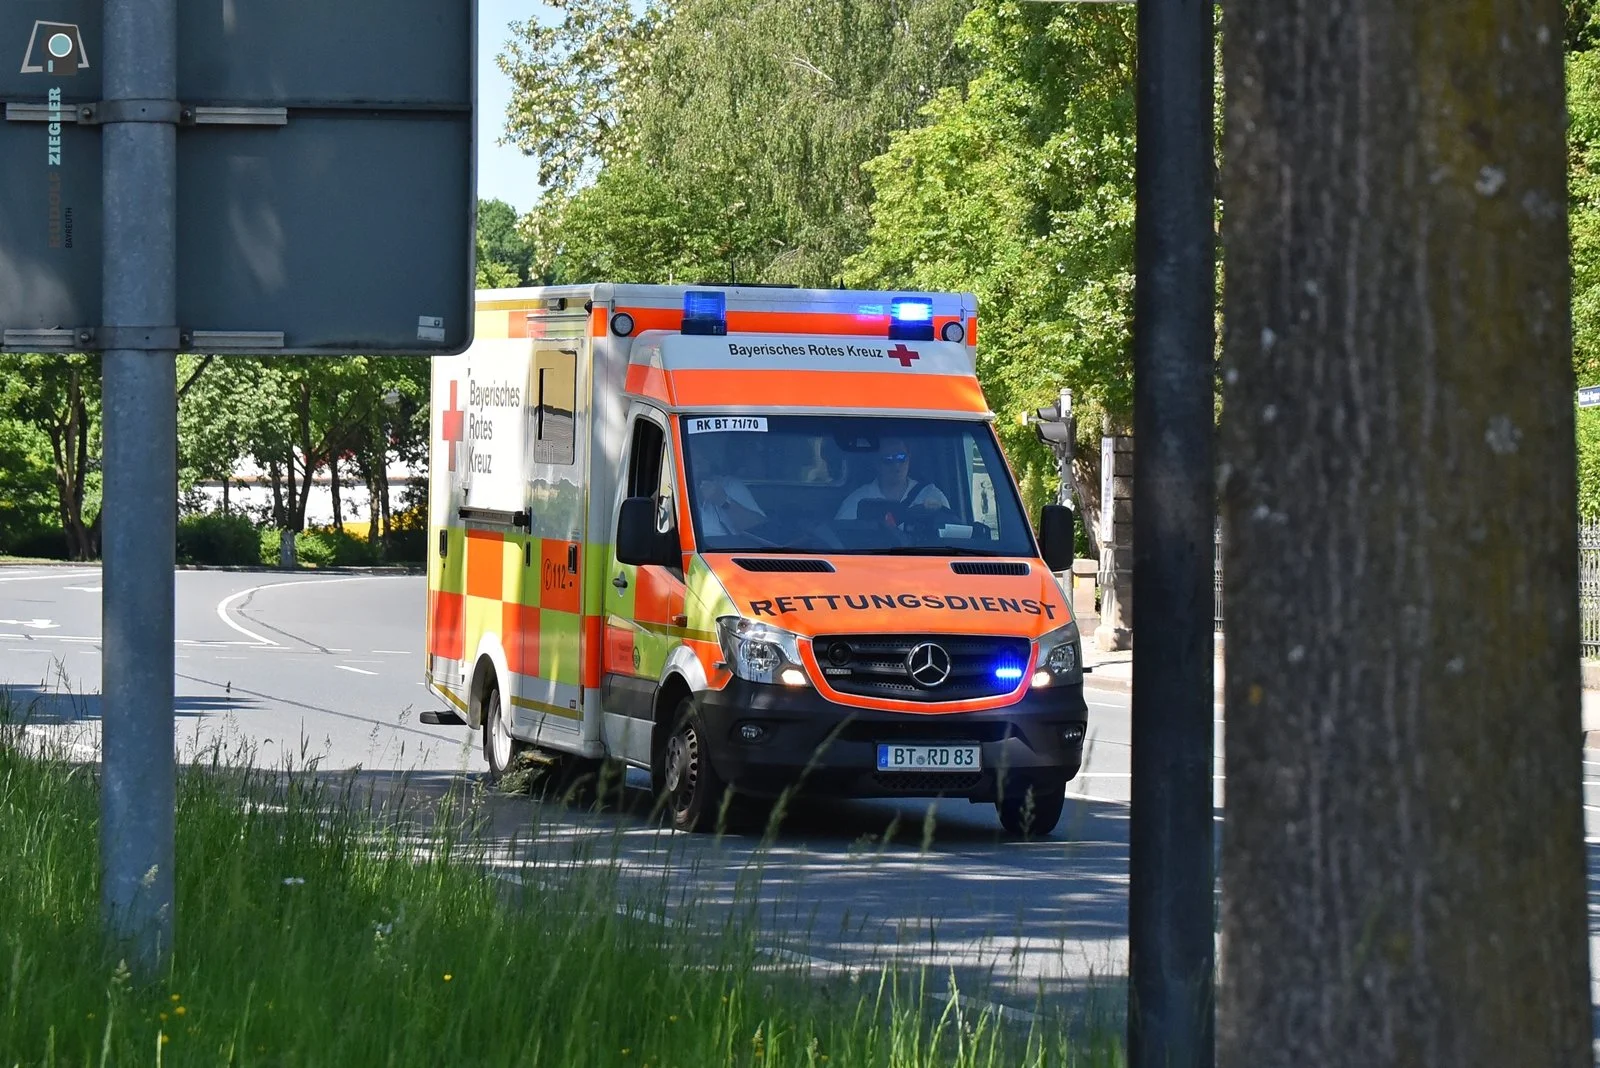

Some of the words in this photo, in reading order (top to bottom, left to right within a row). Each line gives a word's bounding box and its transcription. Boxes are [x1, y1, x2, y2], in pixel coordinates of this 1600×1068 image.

[728, 343, 806, 358] Bayerisches
[807, 344, 845, 357] Rotes
[846, 346, 884, 358] Kreuz
[470, 380, 520, 412] Bayerisches
[469, 413, 493, 440] Rotes
[696, 420, 711, 431] RK
[715, 419, 728, 429] BT
[731, 418, 759, 430] 71/70
[468, 446, 492, 474] Kreuz
[553, 563, 566, 589] 112
[749, 594, 1056, 620] RETTUNGSDIENST
[894, 748, 917, 765] BT
[927, 748, 949, 766] RD
[954, 749, 974, 765] 83
